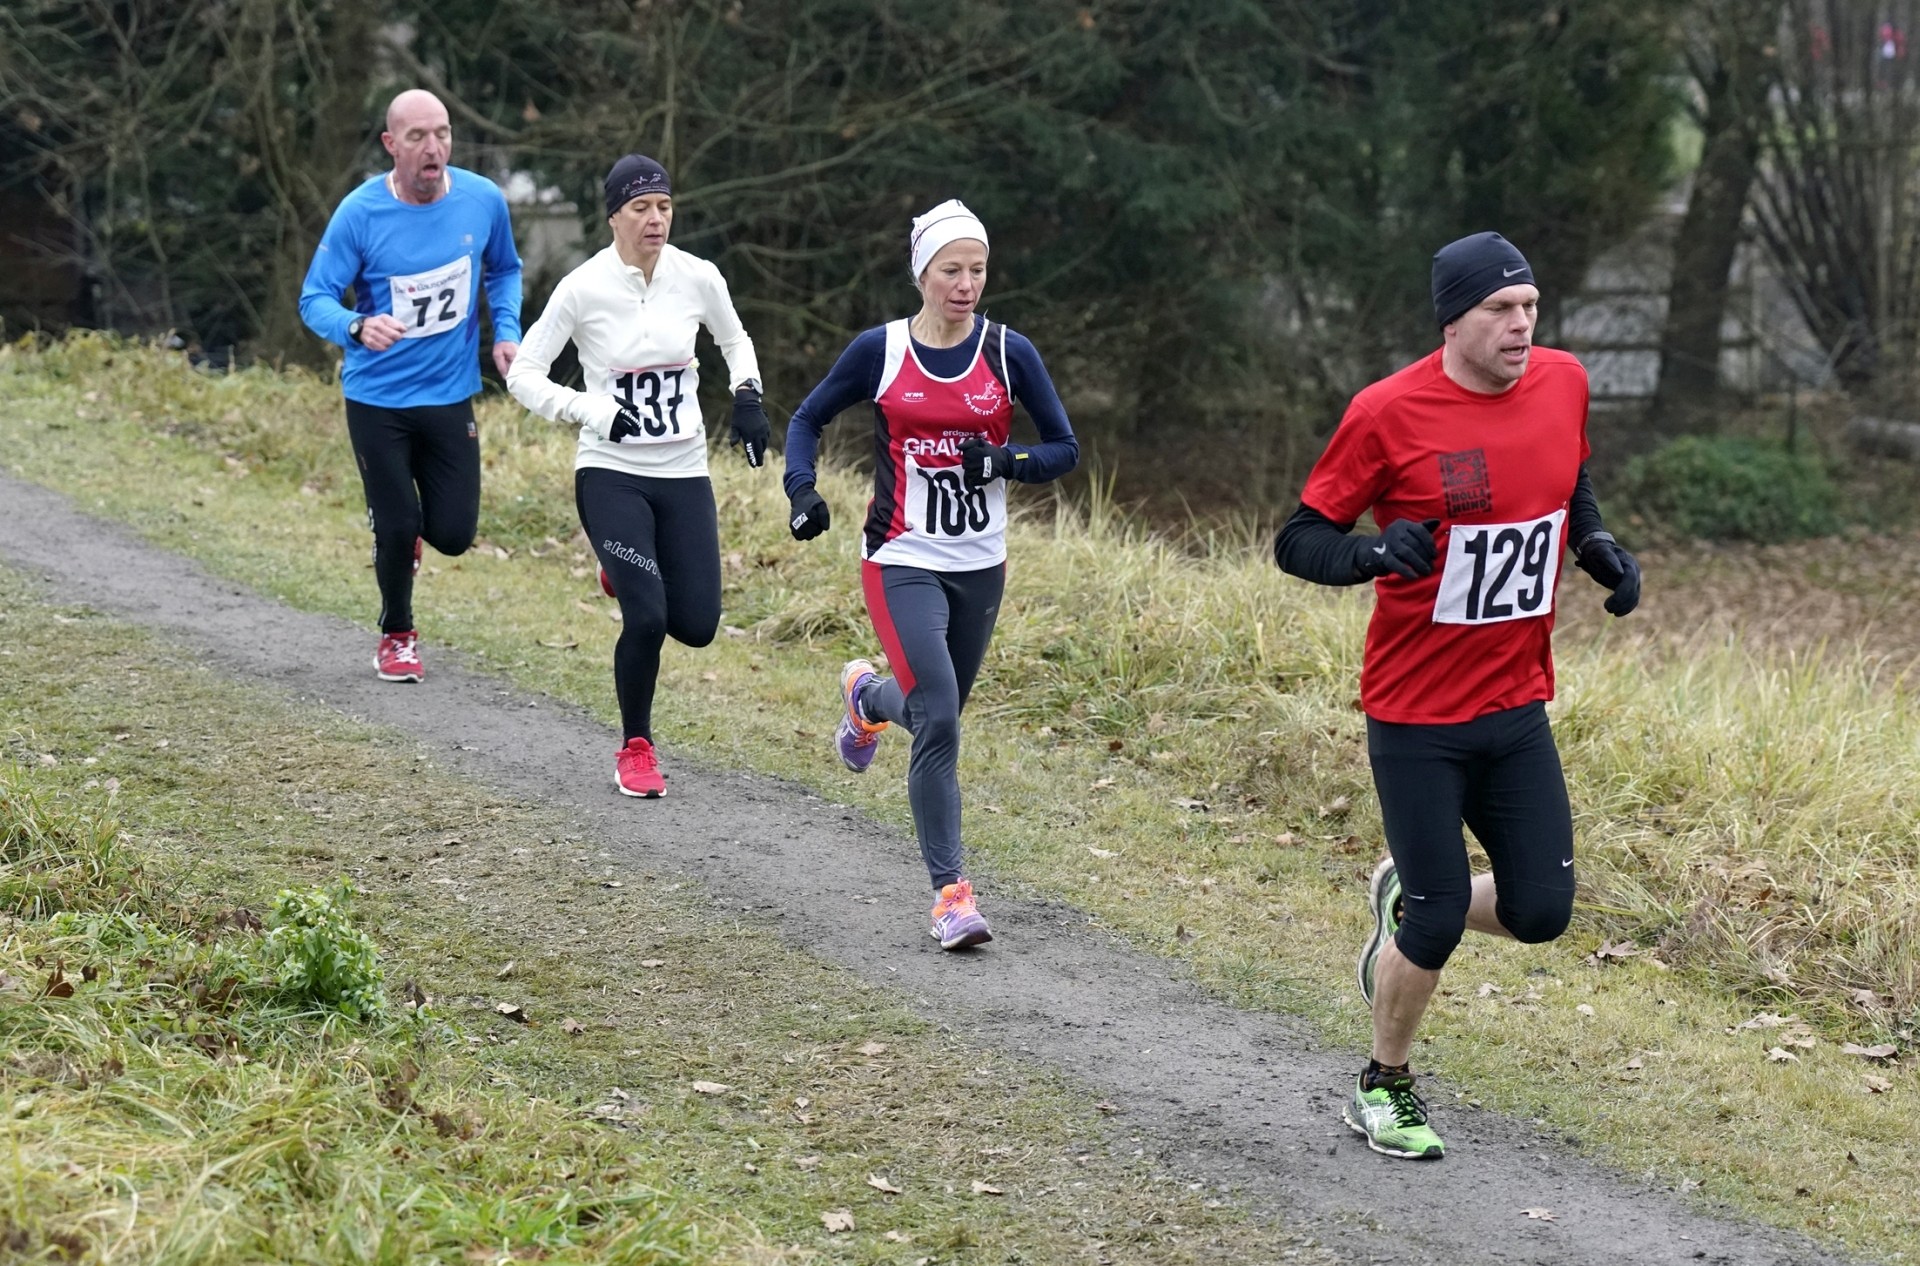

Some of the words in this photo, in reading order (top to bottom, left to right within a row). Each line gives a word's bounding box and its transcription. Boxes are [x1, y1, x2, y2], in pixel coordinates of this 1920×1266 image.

[412, 288, 457, 327] 72
[616, 368, 686, 438] 137
[903, 436, 993, 458] GRAV
[942, 429, 975, 438] erdgas
[915, 467, 990, 537] 106
[1464, 520, 1553, 620] 129
